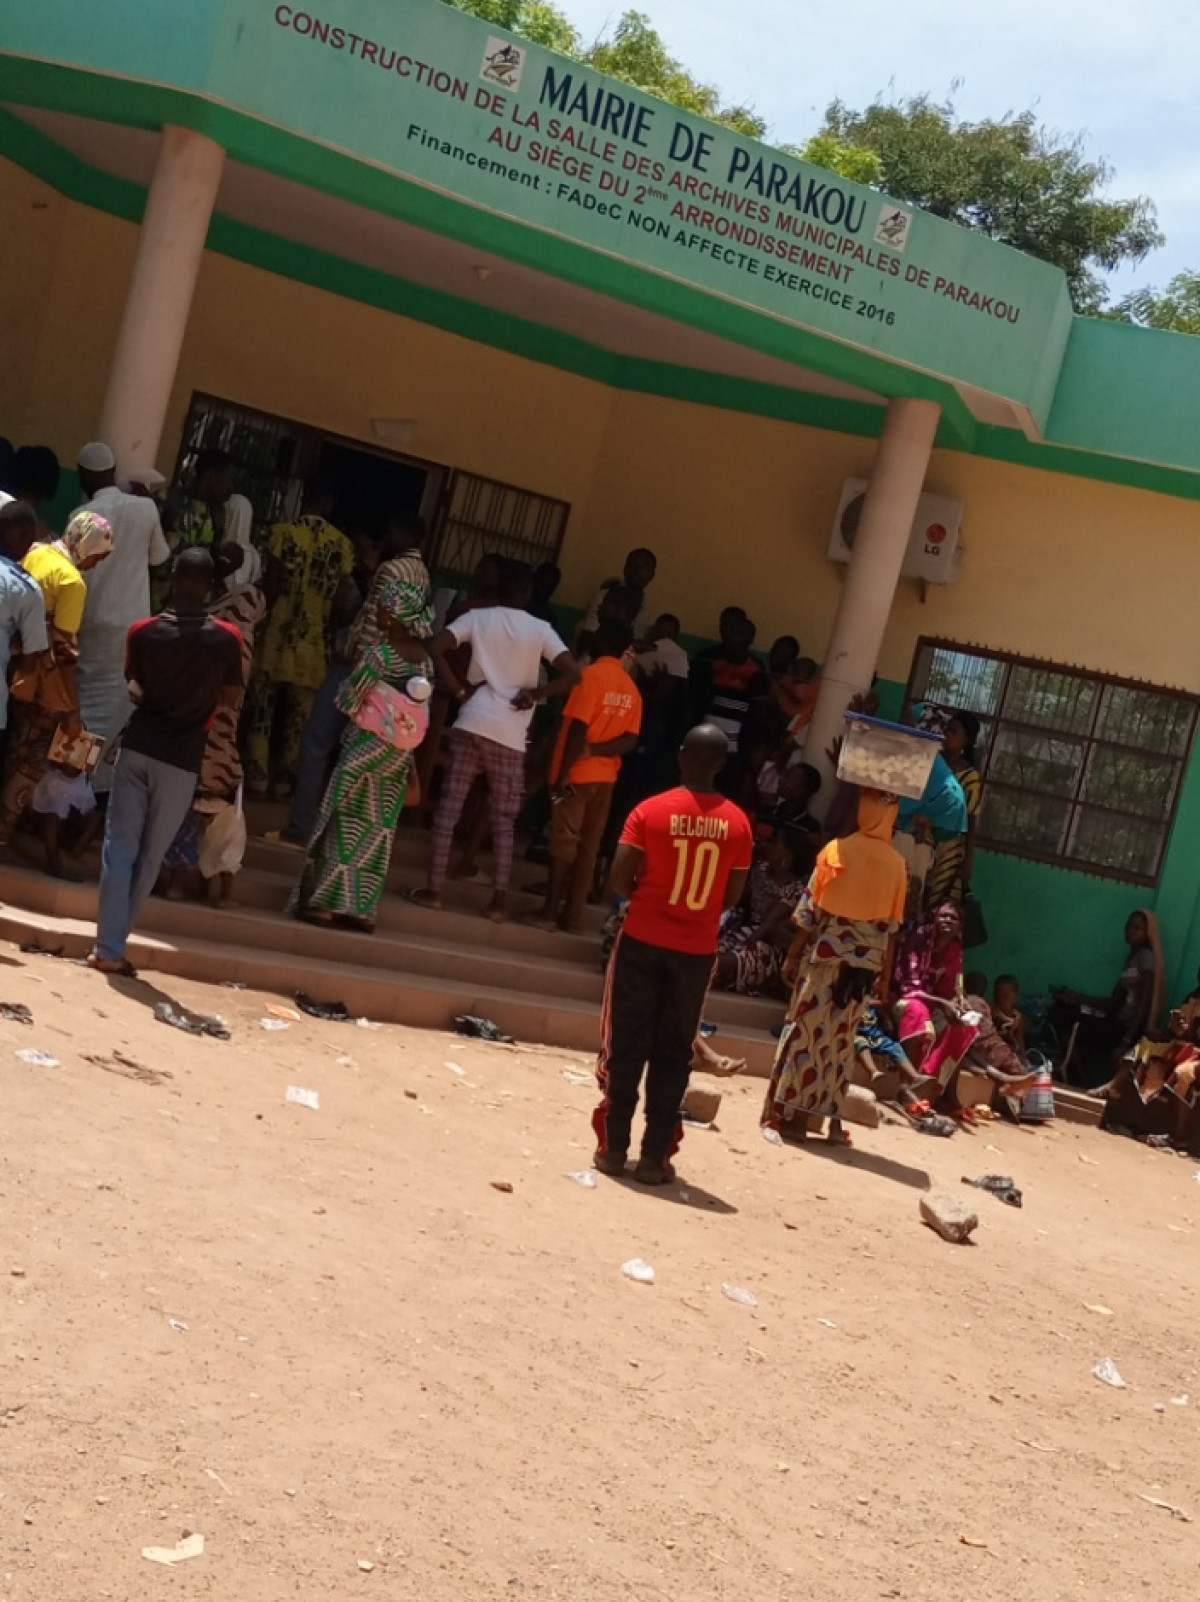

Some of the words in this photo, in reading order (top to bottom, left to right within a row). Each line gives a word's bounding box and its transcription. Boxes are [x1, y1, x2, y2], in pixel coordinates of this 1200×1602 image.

[275, 4, 469, 101] CONSTRUCTION
[473, 87, 507, 117] DE
[511, 103, 540, 132] LA
[546, 118, 618, 164] SALLE
[621, 150, 665, 182] DES
[667, 171, 771, 224] ARCHIVES
[775, 211, 900, 276] MUNICIPALES
[905, 264, 931, 289] DE
[933, 276, 1021, 325] PARAKOU
[406, 123, 541, 190] Financement
[556, 183, 622, 220] FADeC
[627, 209, 671, 239] NON
[673, 229, 760, 274] AFFECTE
[763, 264, 854, 310] EXERCICE
[856, 301, 896, 326] 2016
[487, 126, 522, 153] AU
[527, 141, 594, 183] SIÈGE
[598, 170, 630, 197] DU
[670, 200, 854, 284] ARRONDISSEMENT
[538, 65, 655, 148] MAIRIE
[668, 122, 715, 173] DE
[727, 146, 867, 233] PARAKOU
[924, 543, 941, 556] LG
[667, 838, 720, 910] 10
[669, 814, 729, 840] BELGIUM
